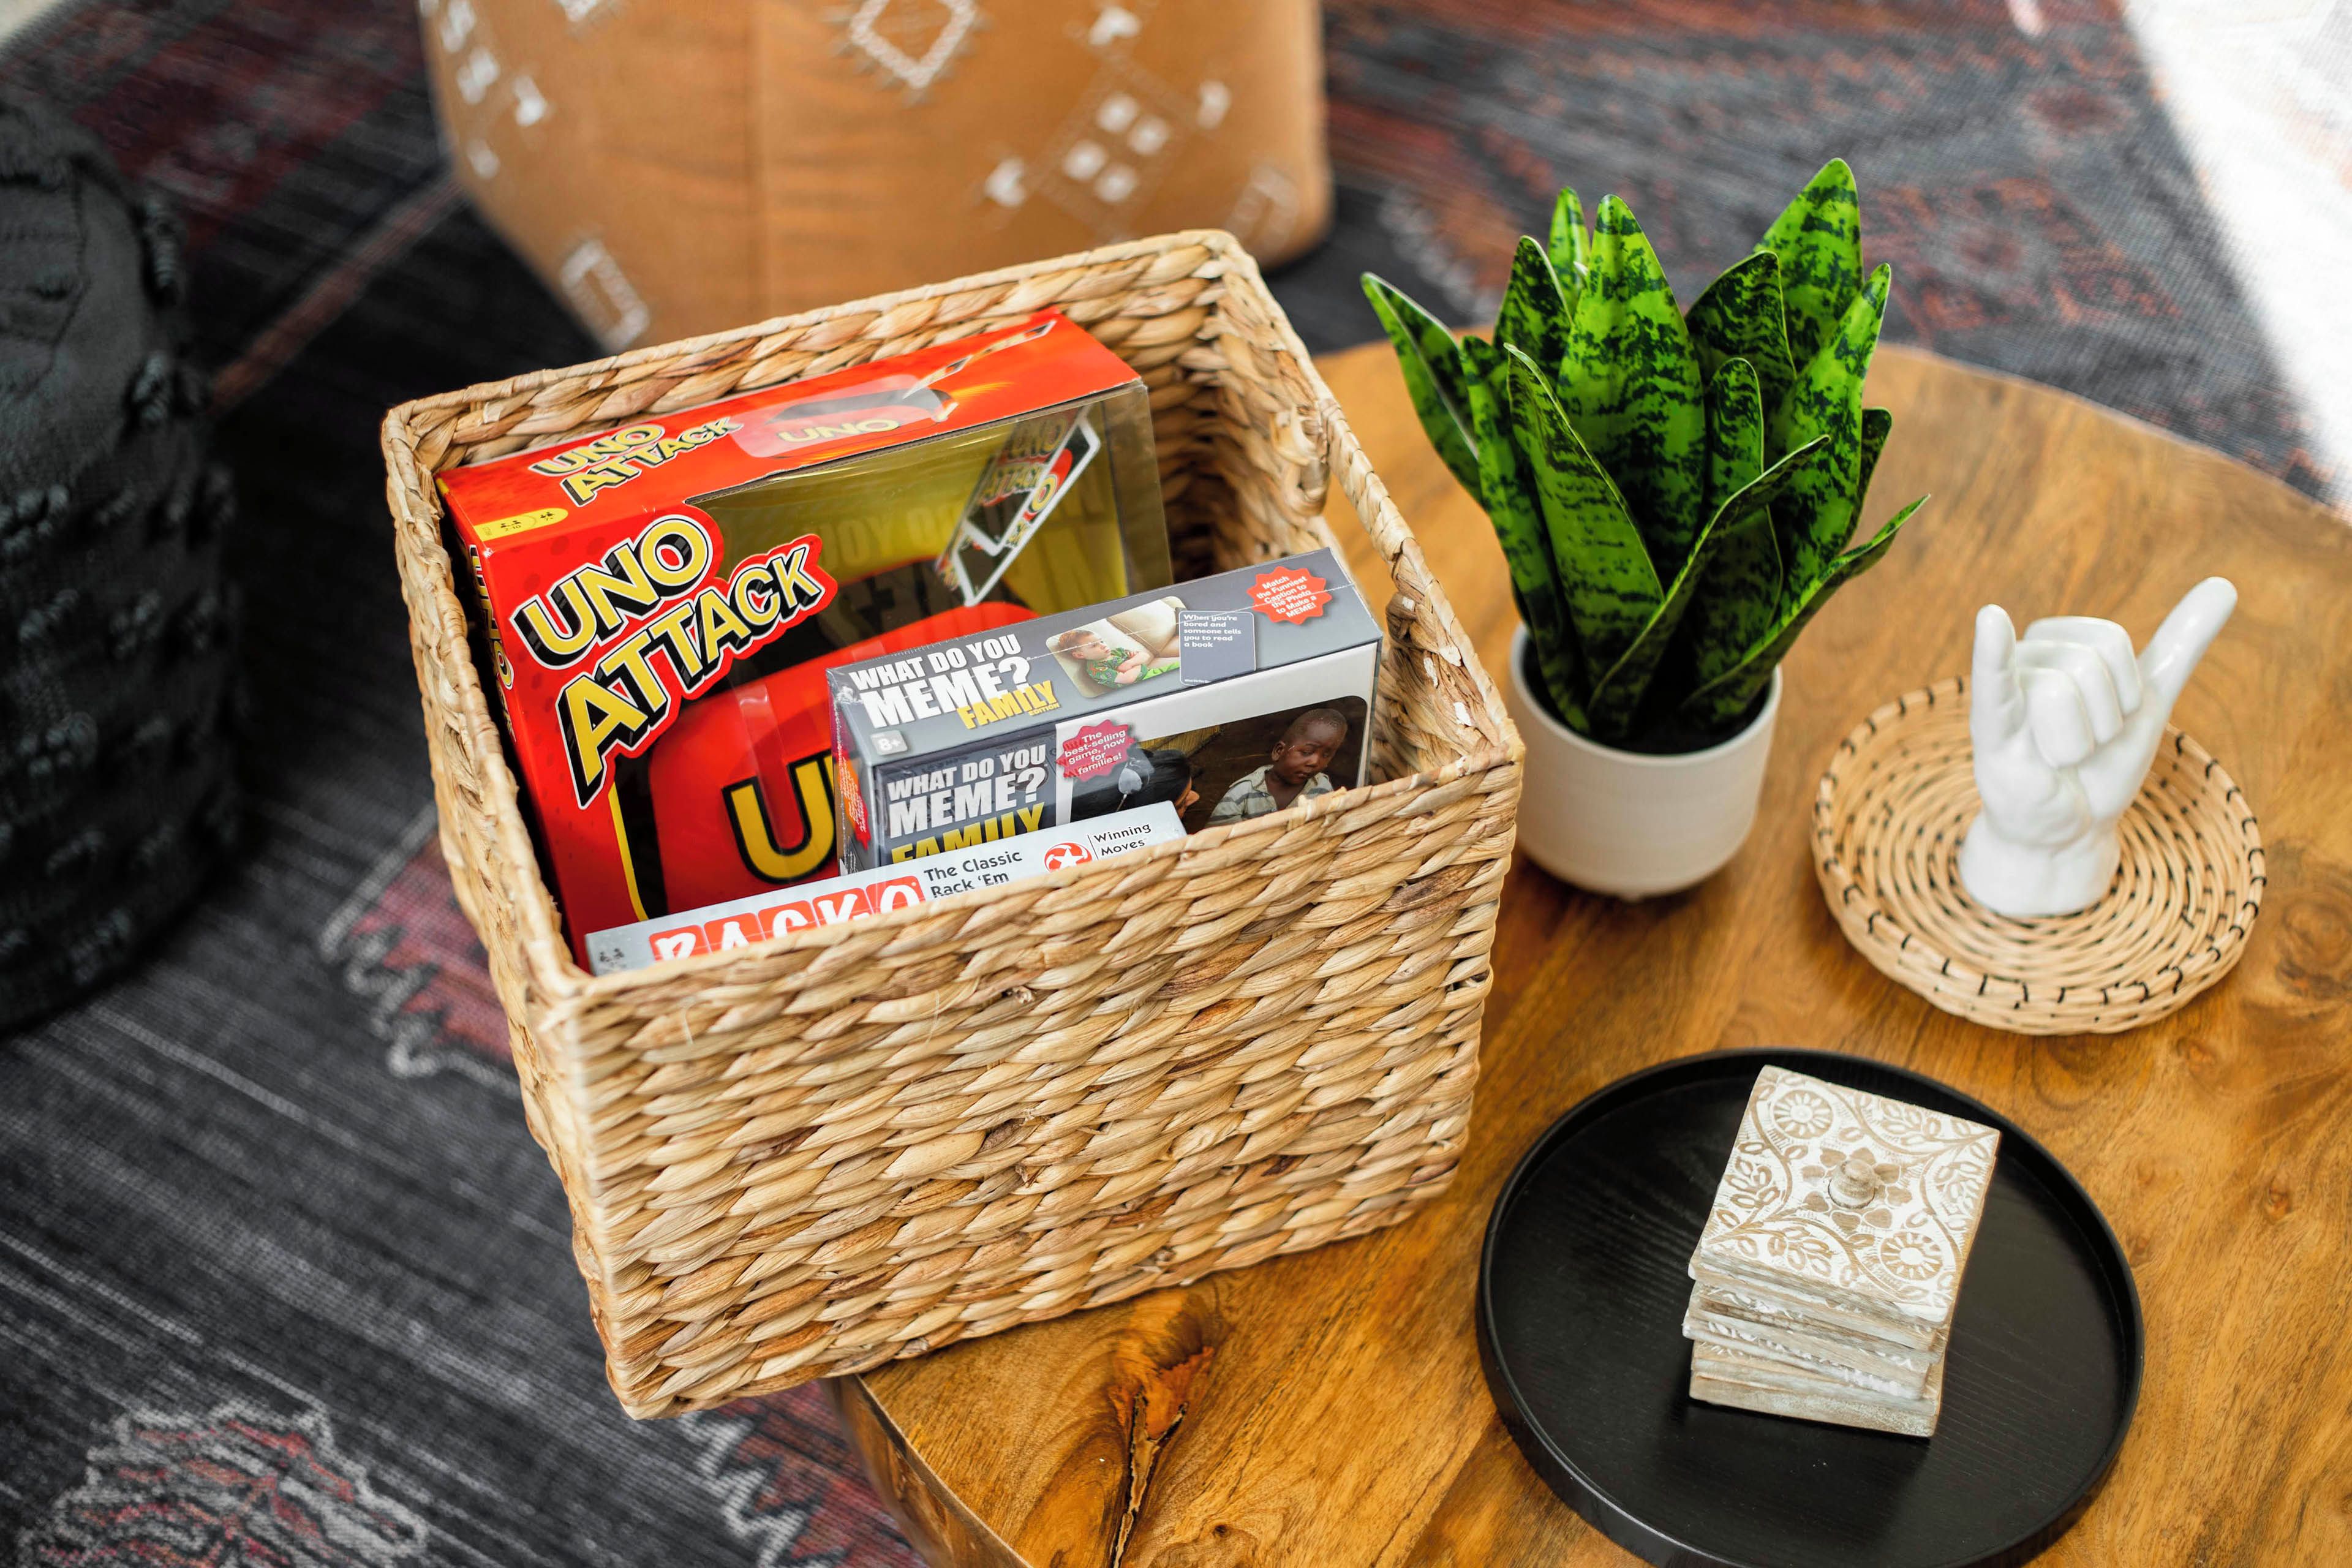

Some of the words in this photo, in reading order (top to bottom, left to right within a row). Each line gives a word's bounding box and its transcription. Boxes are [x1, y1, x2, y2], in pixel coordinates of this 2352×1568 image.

[777, 418, 902, 443] UNO
[529, 424, 665, 475] UNO
[560, 417, 743, 507] ATTACK
[510, 514, 714, 670] UNO
[1256, 590, 1272, 599] the
[1271, 576, 1308, 594] Funniest
[1262, 576, 1290, 589] Match
[1264, 588, 1297, 603] Caption
[1271, 600, 1286, 608] the
[1286, 590, 1311, 602] Photo
[1286, 598, 1310, 610] Make
[1286, 602, 1316, 618] MEME!
[848, 657, 925, 691] WHAT
[927, 648, 967, 673] DO
[966, 634, 1021, 663] YOU
[556, 541, 824, 809] ATTACK
[859, 657, 1030, 729] MEME?
[956, 680, 1058, 729] FAMILY
[1028, 703, 1060, 716] EDITION
[878, 737, 901, 752] 8+
[1065, 729, 1126, 758] best-selling
[1082, 732, 1102, 743] The
[1068, 748, 1101, 765] game,
[1103, 737, 1125, 750] now
[1091, 752, 1106, 762] for
[888, 767, 957, 801] WHAT
[962, 758, 993, 782] DO
[1000, 744, 1046, 773] YOU
[1078, 752, 1122, 775] families!
[889, 767, 1046, 839] MEME?
[1093, 823, 1152, 843] Winning
[1101, 838, 1145, 857] Moves
[924, 865, 958, 883] The
[962, 851, 1023, 873] Classic
[930, 880, 974, 899] Rack
